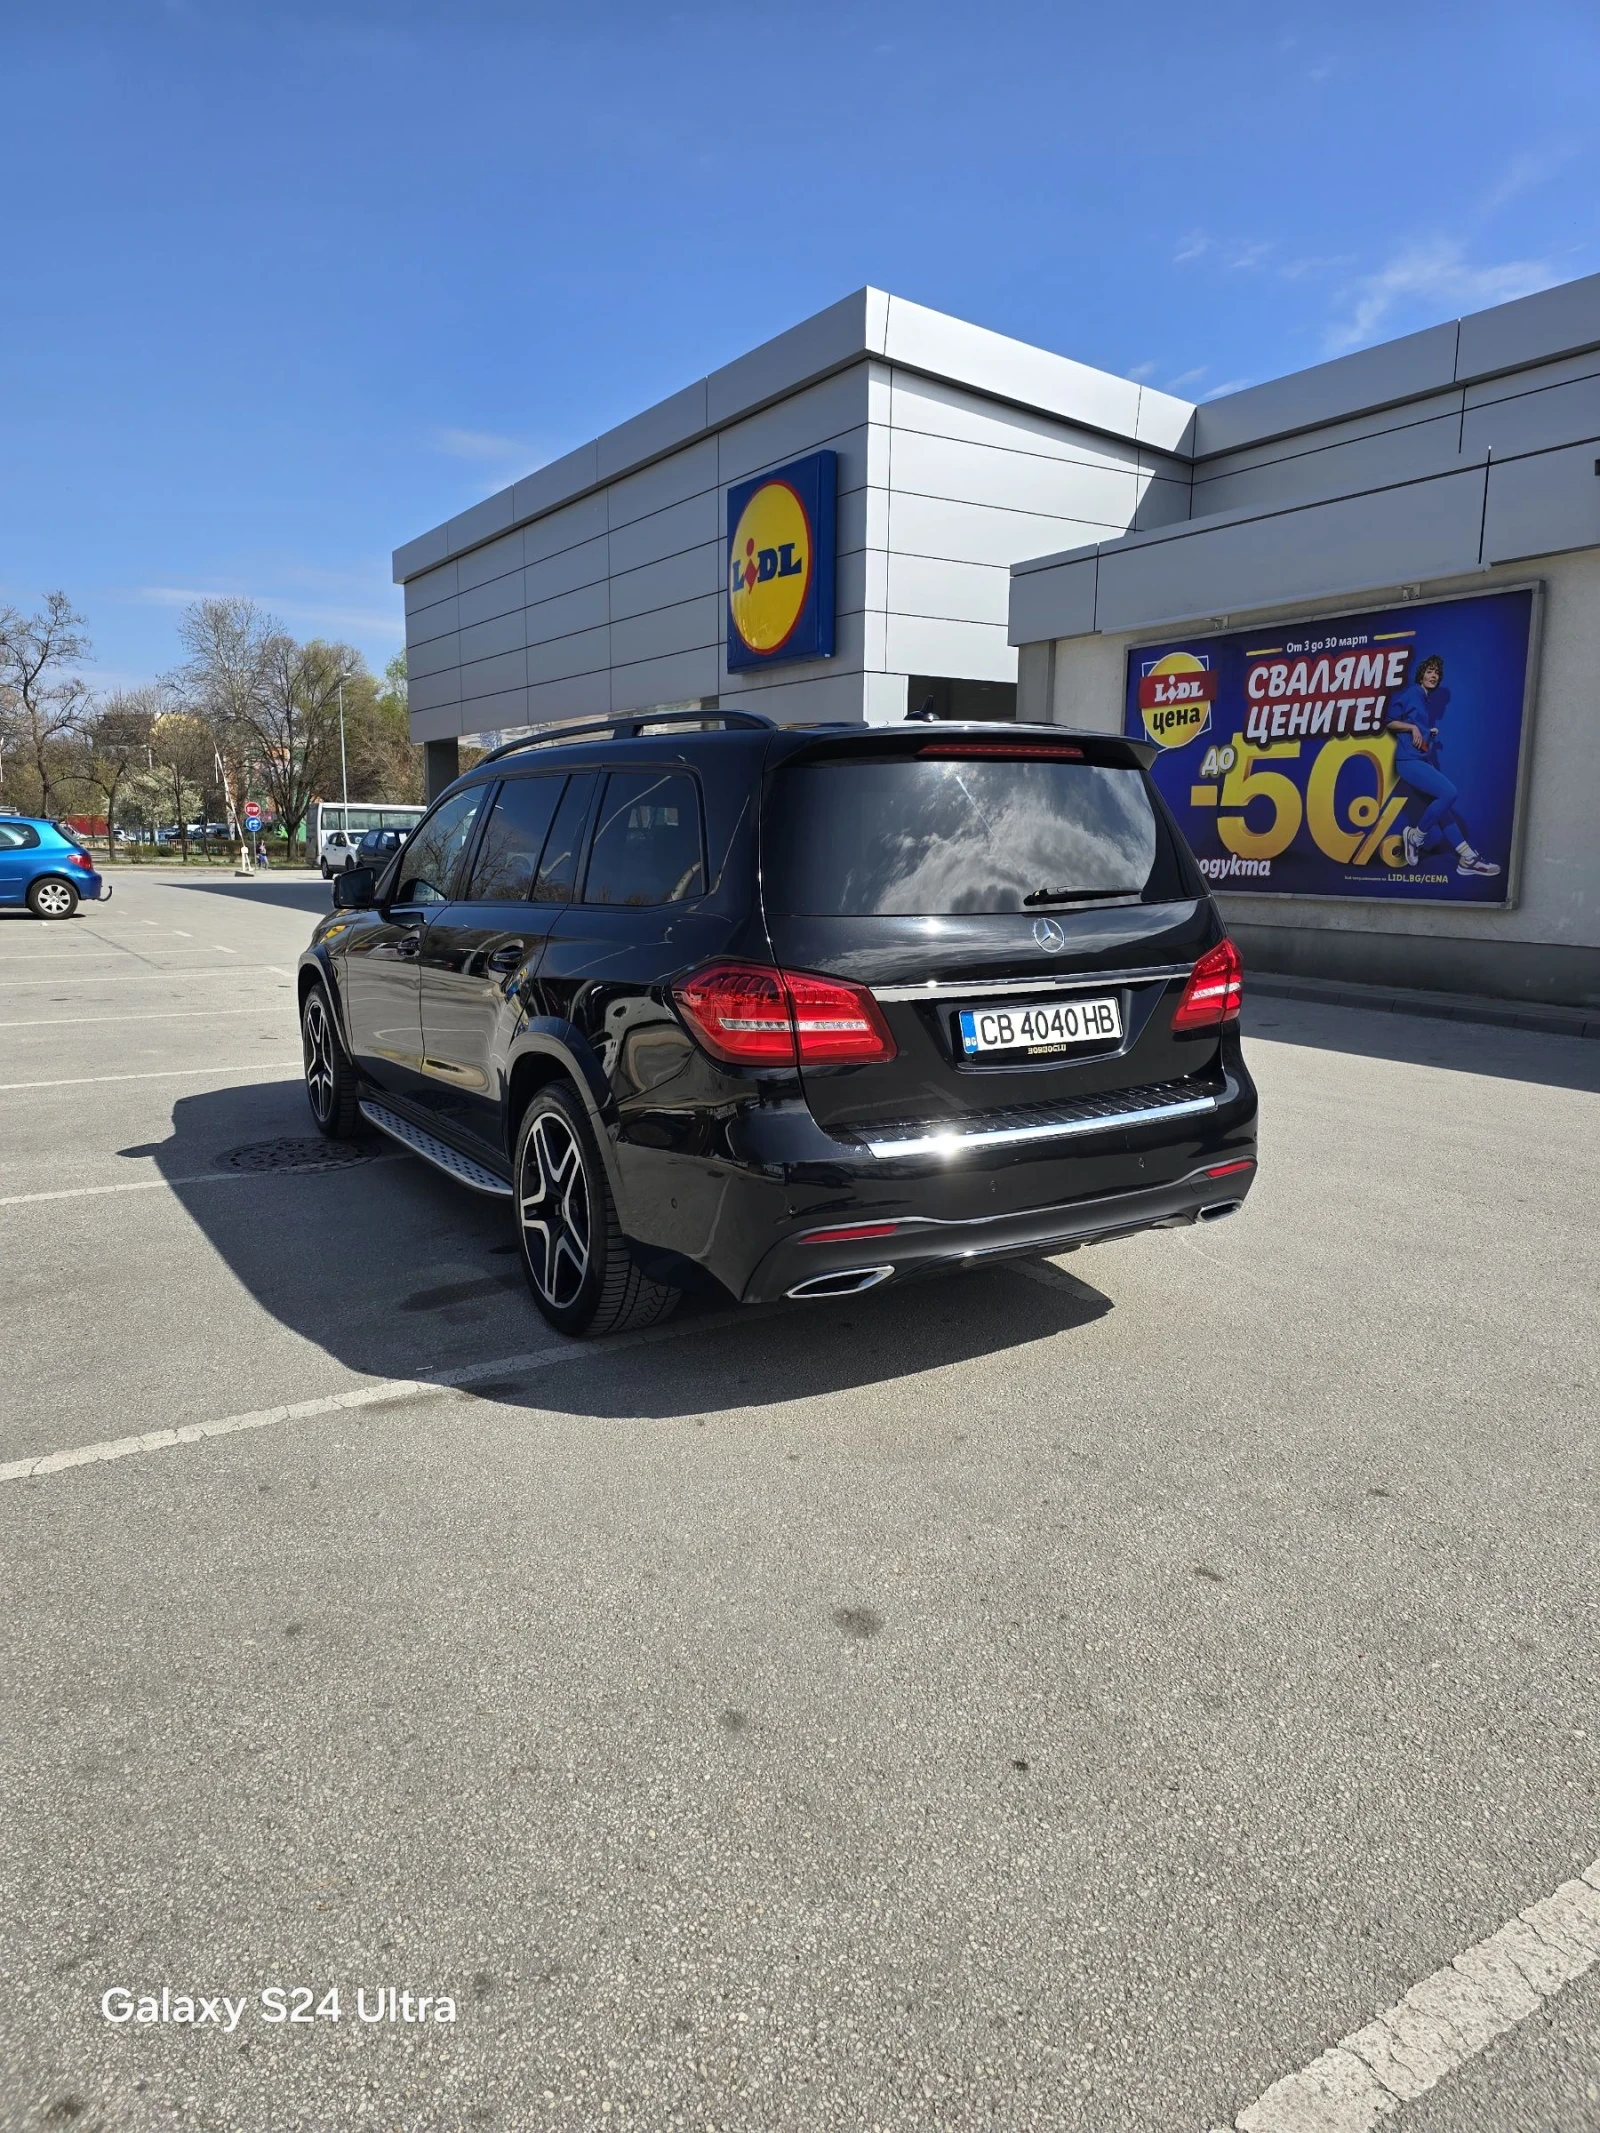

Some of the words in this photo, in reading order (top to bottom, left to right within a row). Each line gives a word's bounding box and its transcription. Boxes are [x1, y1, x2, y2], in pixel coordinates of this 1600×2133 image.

[1286, 642, 1302, 653] От
[1304, 640, 1310, 651] 3
[1311, 641, 1323, 653] до
[1325, 637, 1337, 649] 30
[1339, 635, 1368, 648] март
[1247, 650, 1409, 699] СВАЛЯМЕ
[1153, 707, 1201, 735] цена
[1246, 695, 1386, 744] ЦЕНИТЕ!
[1191, 732, 1409, 867] -50%
[1196, 853, 1271, 879] одукта
[1387, 873, 1449, 884] LIDL.BG/CENA
[980, 1014, 1015, 1045] CB
[1020, 1008, 1079, 1041] 4040
[1082, 1004, 1115, 1035] HB
[965, 1036, 977, 1047] BG
